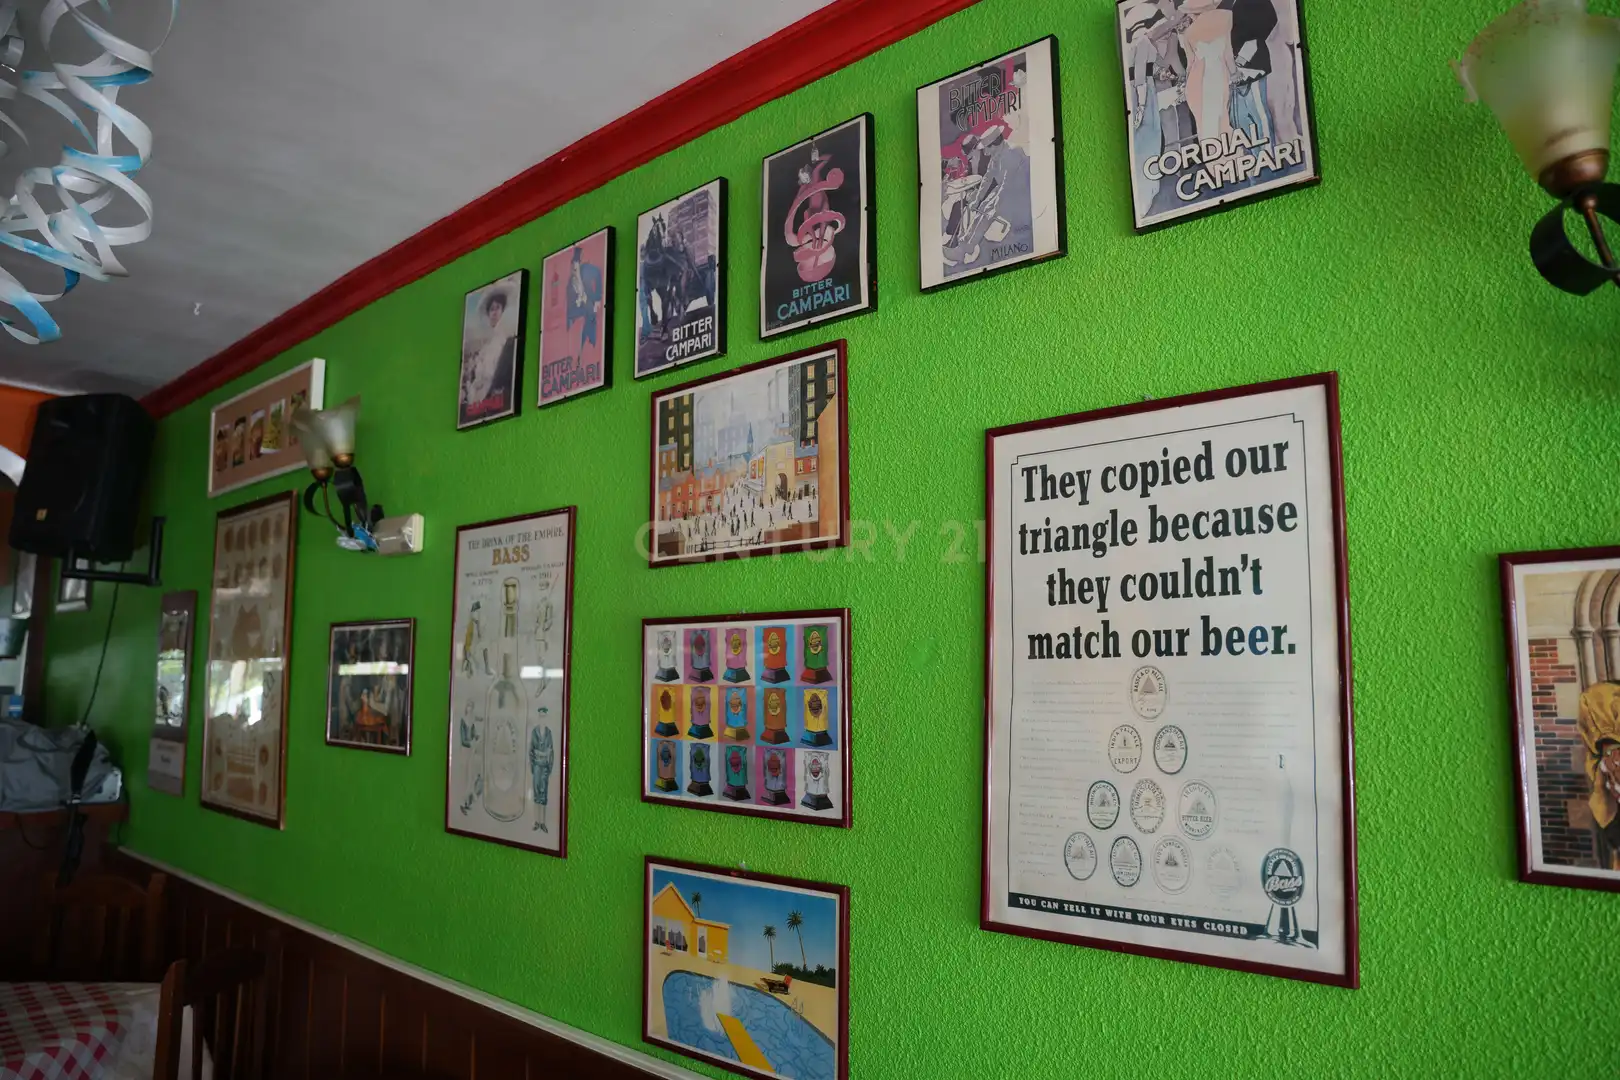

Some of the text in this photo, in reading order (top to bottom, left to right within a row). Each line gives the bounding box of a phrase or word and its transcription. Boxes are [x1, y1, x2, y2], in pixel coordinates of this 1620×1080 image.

[956, 88, 1022, 131] CAMPARI
[1143, 123, 1269, 180] CORDIAL
[1175, 139, 1303, 201] CAMPARI
[991, 243, 1029, 260] MILANO
[776, 284, 850, 320] CAMPARI
[792, 278, 833, 299] BITTER
[666, 333, 712, 361] CAMPARI
[672, 316, 713, 342] BITTER
[541, 362, 601, 398] CAMPARI
[542, 356, 573, 380] BITTER
[1021, 440, 1289, 506] They copied our
[517, 532, 533, 543] THE
[1019, 500, 1298, 558] triangle because
[492, 544, 530, 566] BASS
[1046, 553, 1263, 613] they couldn't
[1028, 615, 1296, 660] match our beer.
[1114, 757, 1138, 765] EXPORT
[1264, 875, 1303, 892] Bass
[1018, 896, 1248, 935] YOU CAN TELL IT WITH YOUR EYES CLOSED
